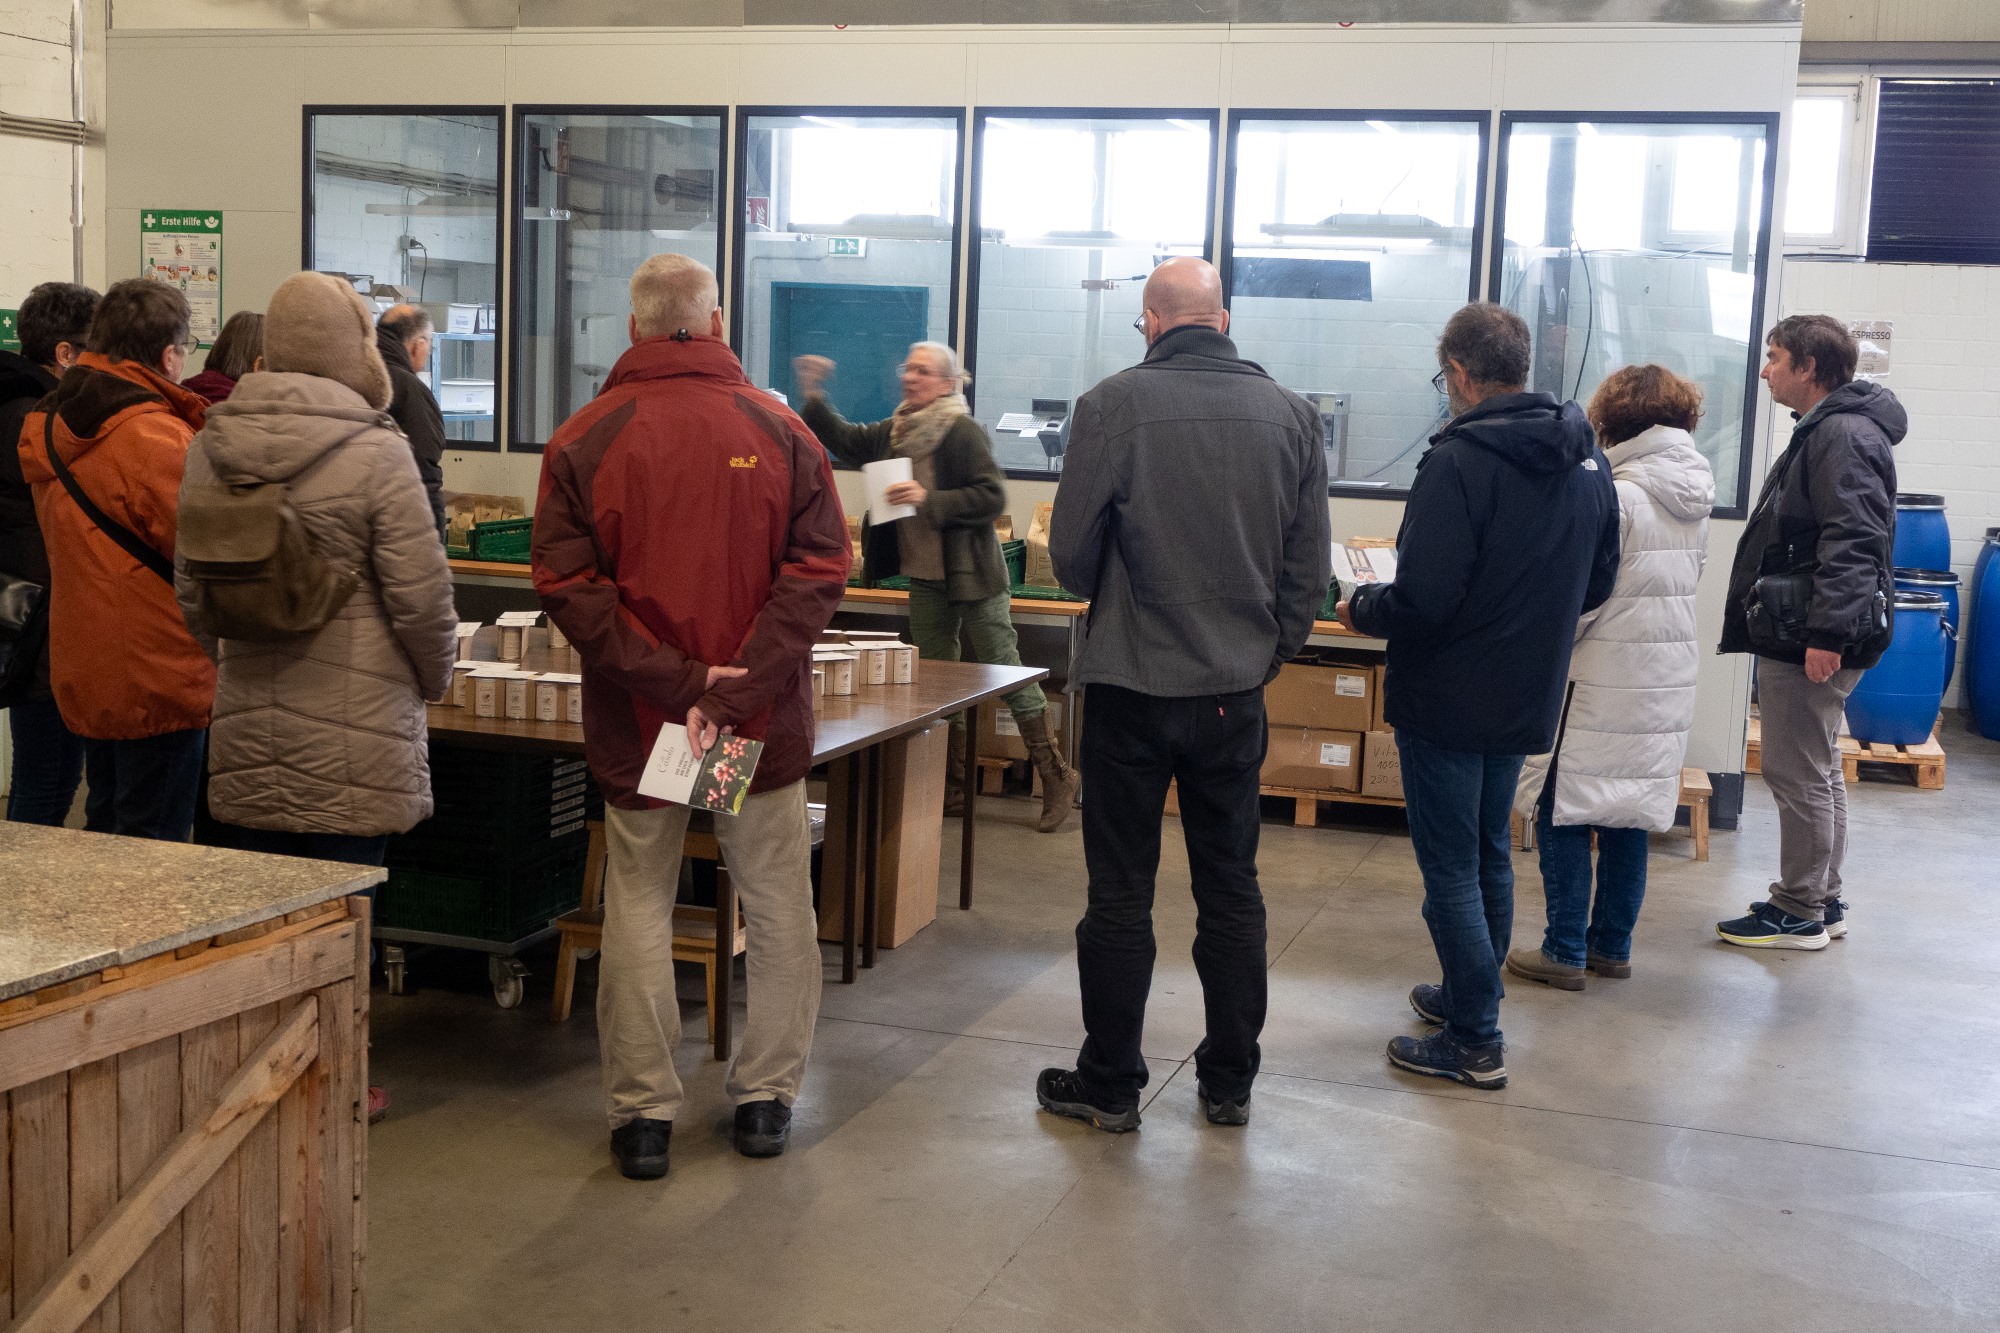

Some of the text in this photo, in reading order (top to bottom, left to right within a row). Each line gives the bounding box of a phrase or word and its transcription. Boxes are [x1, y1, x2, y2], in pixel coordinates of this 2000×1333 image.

[161, 216, 201, 226] Erste Hilfe
[1851, 331, 1890, 340] ESPRESSO
